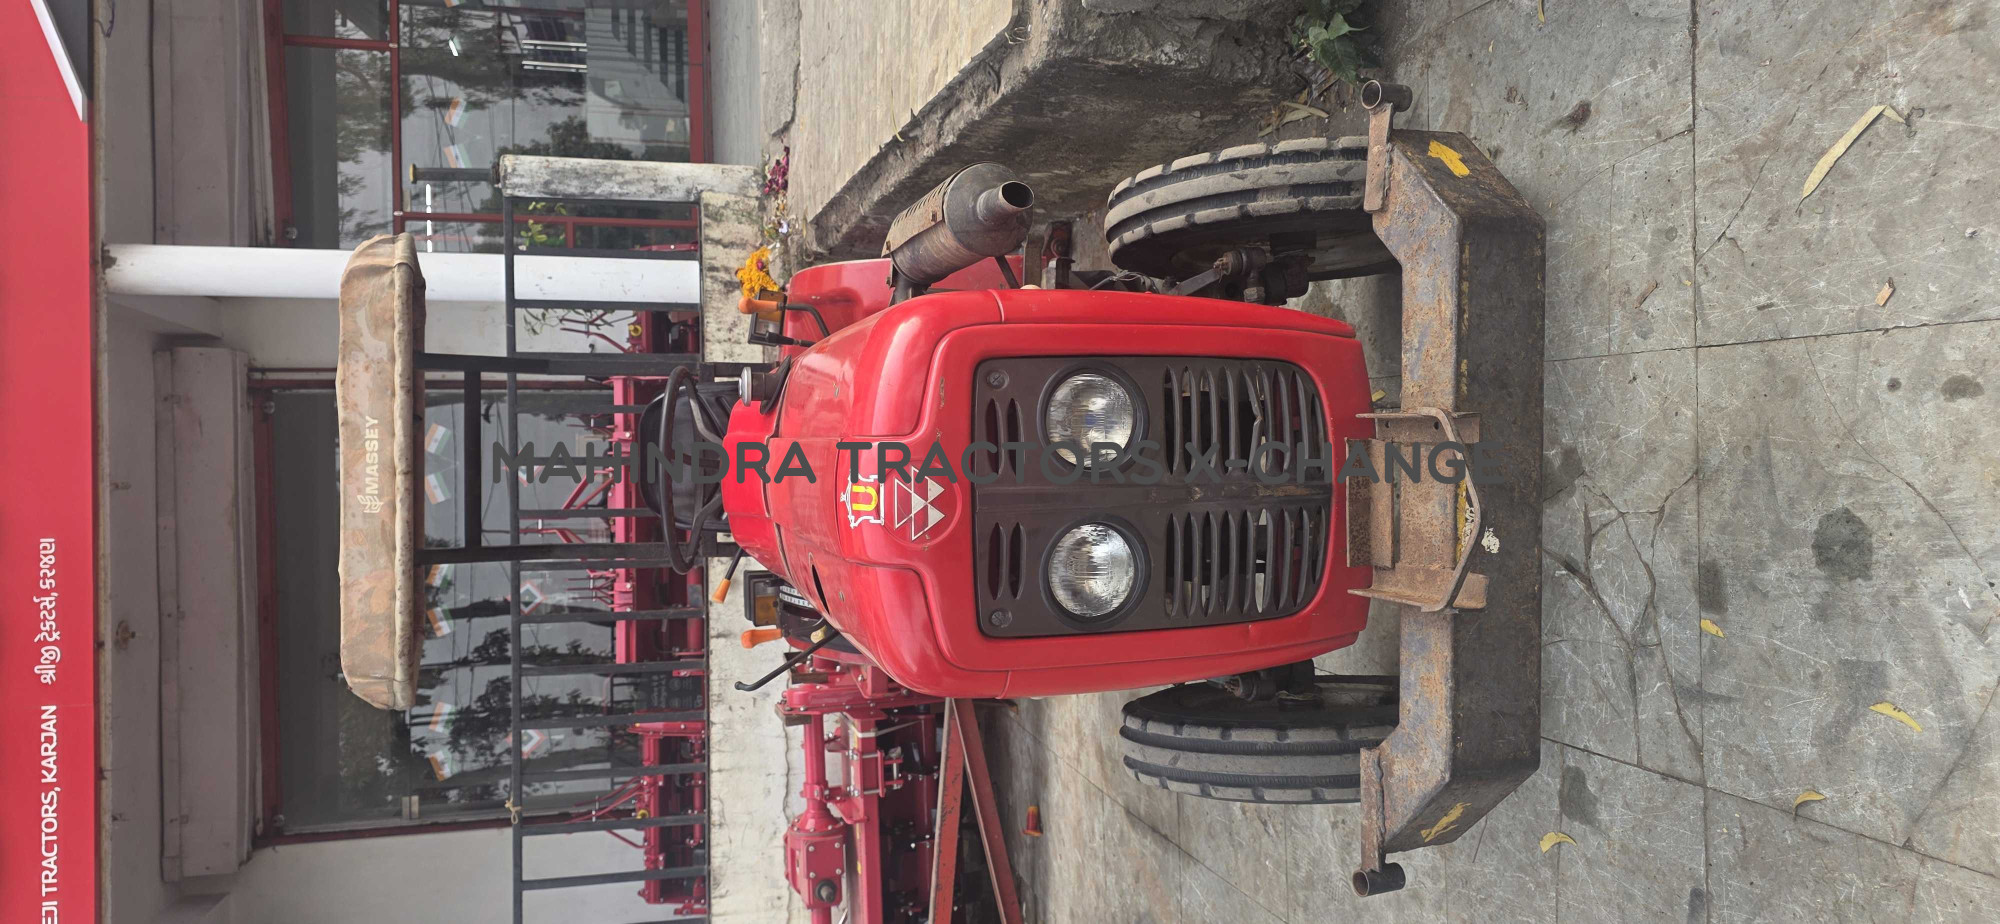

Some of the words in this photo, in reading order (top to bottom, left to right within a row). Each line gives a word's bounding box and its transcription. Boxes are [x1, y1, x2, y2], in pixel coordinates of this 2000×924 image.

[365, 415, 379, 495] MASSEY
[852, 485, 878, 511] U
[39, 538, 56, 590] કરજણ
[34, 645, 61, 685] શ્રીજી
[41, 705, 57, 783] KARJAN
[41, 787, 61, 897] TRACTORS,
